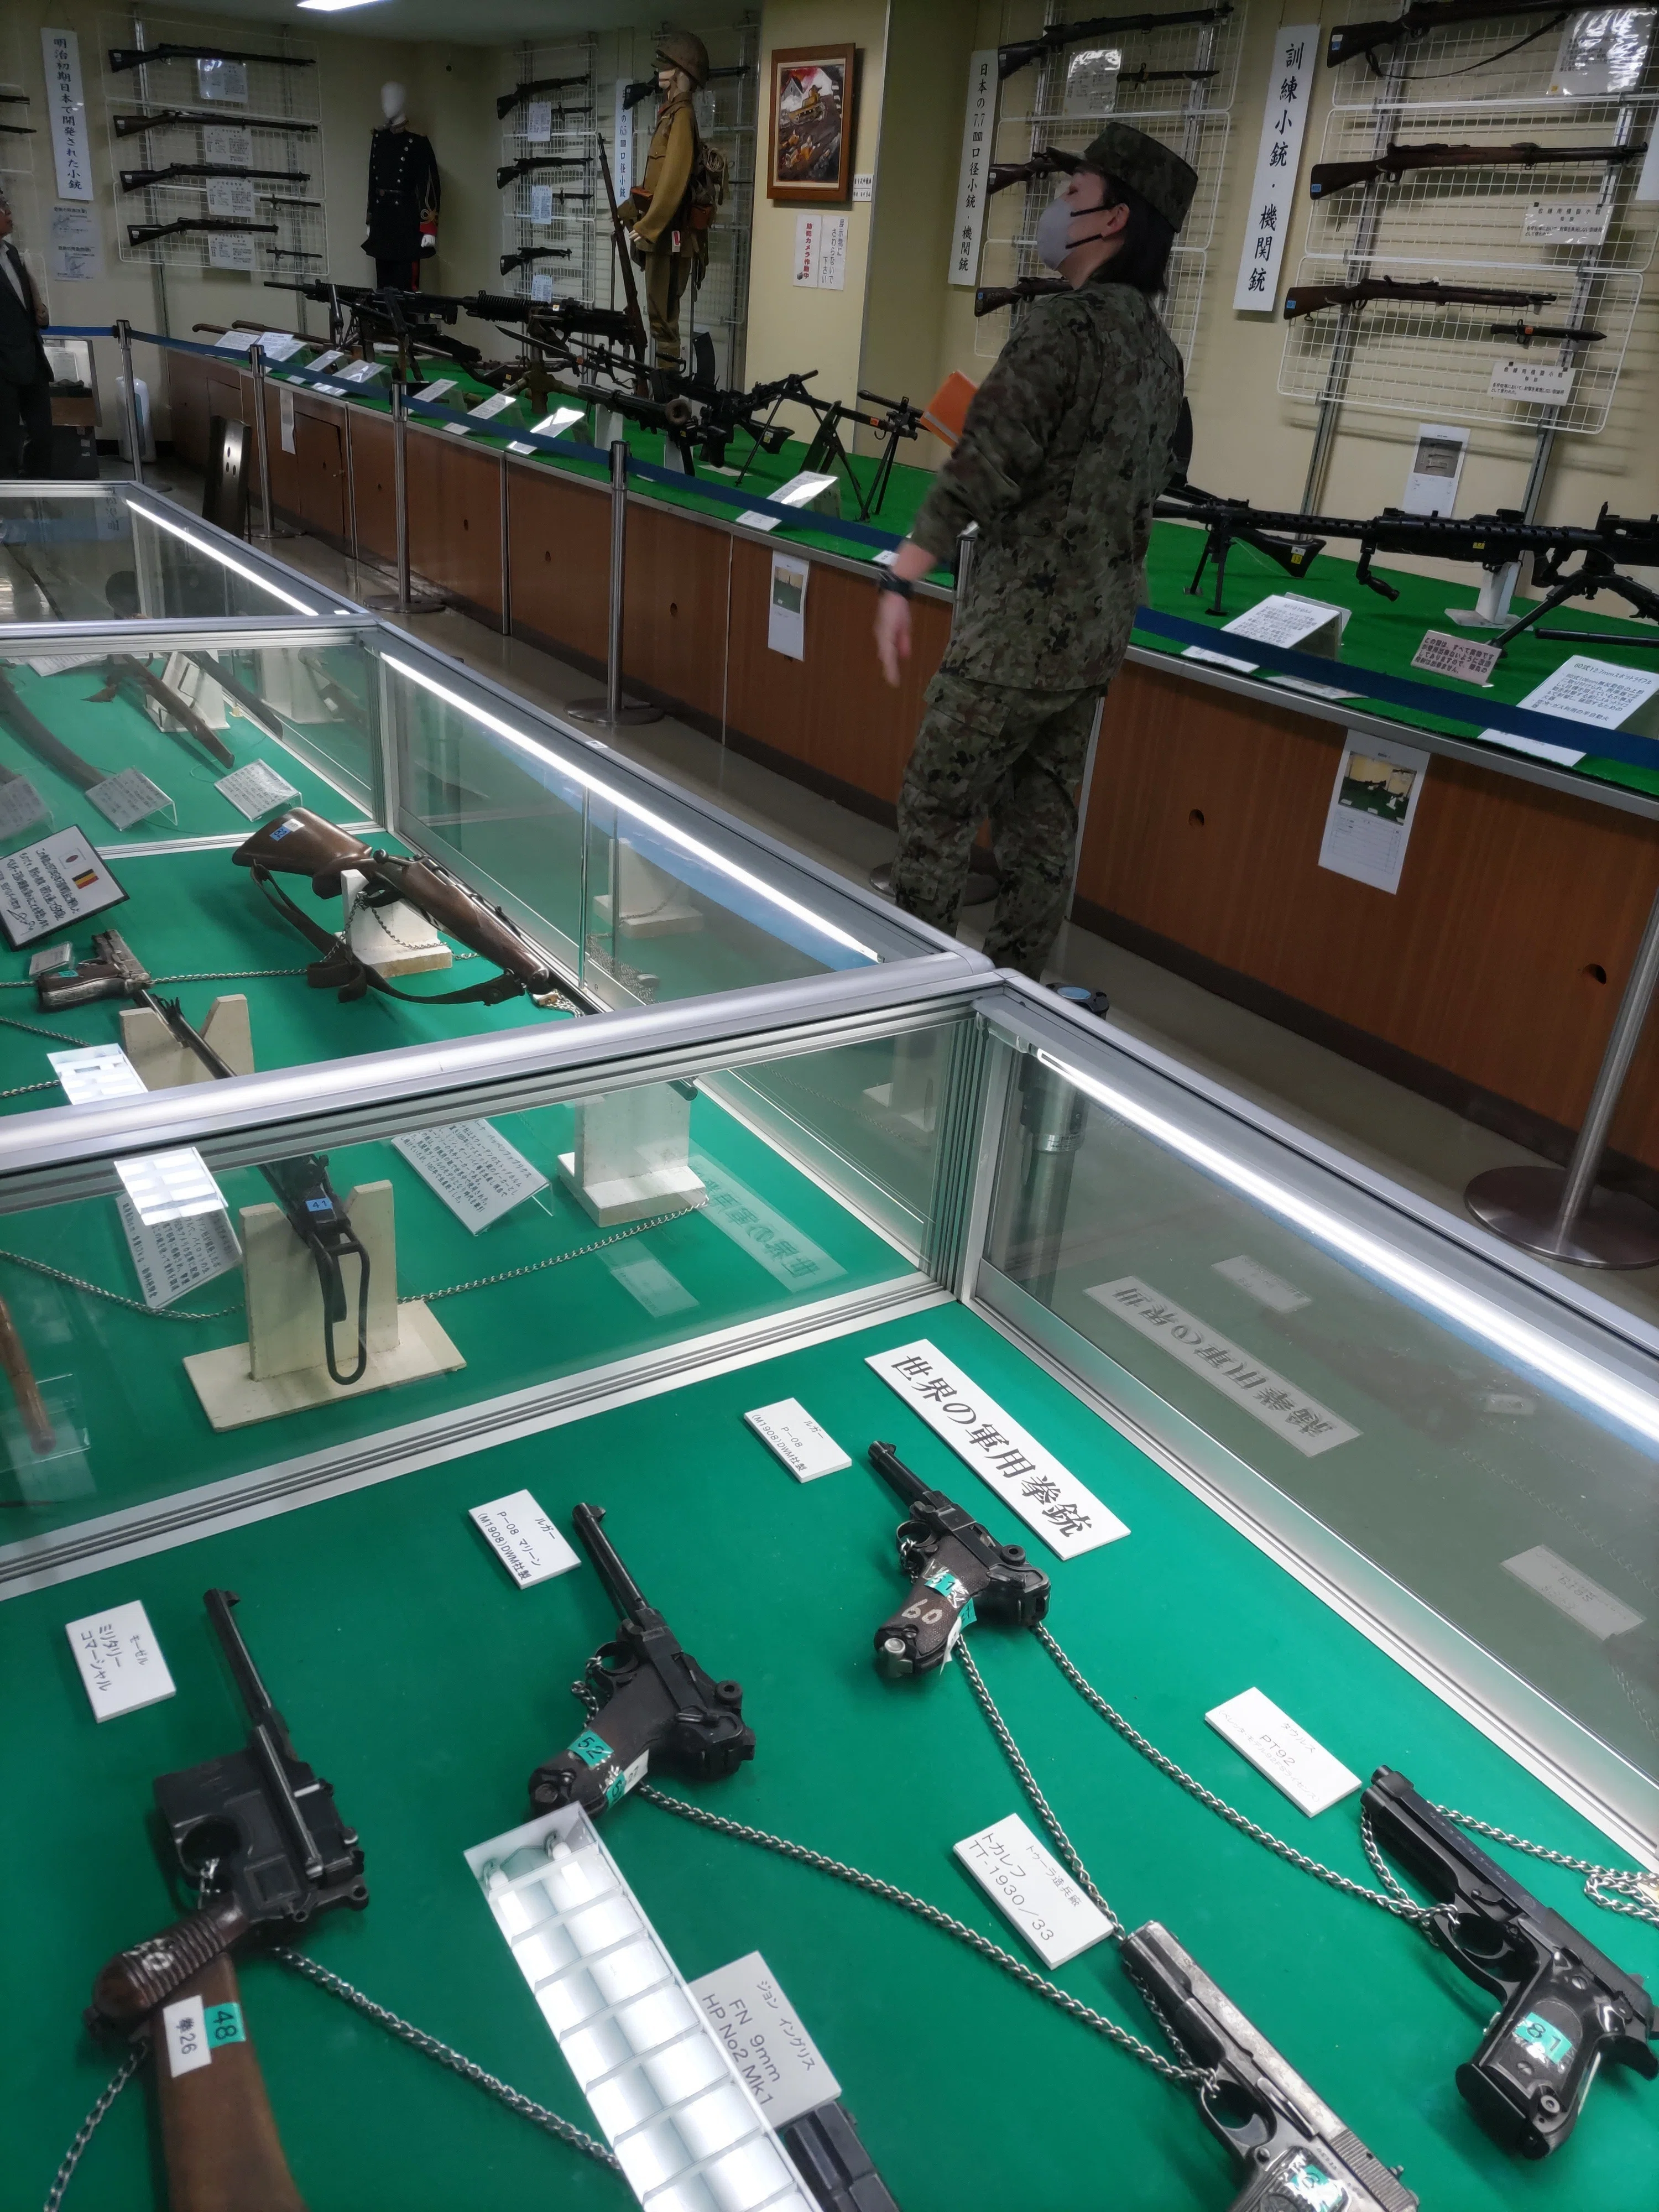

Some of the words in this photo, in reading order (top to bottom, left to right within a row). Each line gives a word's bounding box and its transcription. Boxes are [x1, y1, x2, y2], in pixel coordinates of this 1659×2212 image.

[54, 38, 82, 189] 明治初期日本で開発された小銃
[1248, 42, 1303, 292] 訓練小銃・機関銃
[804, 223, 813, 279] 防犯カメラ作動中
[828, 229, 837, 284] さわらないで
[274, 828, 287, 838] 82
[312, 1199, 327, 1208] 41
[752, 1413, 807, 1472] (M1908)DWM社製
[804, 1419, 824, 1439] ルガー
[890, 1355, 1093, 1538] 世界の軍用拳銃
[477, 1512, 530, 1580] (M1908)DWM社製
[519, 1536, 542, 1567] マリーン
[534, 1517, 556, 1540] ルガー
[81, 1630, 112, 1691] コマーシャル
[99, 1624, 122, 1668] ミリタリー
[129, 1634, 148, 1666] モーゼル
[578, 1736, 604, 1759] 52
[1259, 1734, 1295, 1766] PT92
[1281, 1722, 1316, 1754] タウルス
[980, 1832, 1026, 1879] トカレフ
[1026, 1845, 1082, 1908] トゥーラ造兵廠
[968, 1839, 1054, 1941] TT-1930/33
[213, 2011, 237, 2040] 48
[702, 1993, 726, 2020] HP
[719, 2026, 749, 2063] No2
[742, 2066, 773, 2105] Mk1
[728, 1998, 753, 2025] FN
[750, 2034, 781, 2082] 9mm
[757, 1979, 778, 2009] ジョン
[779, 2017, 815, 2071] イングリス
